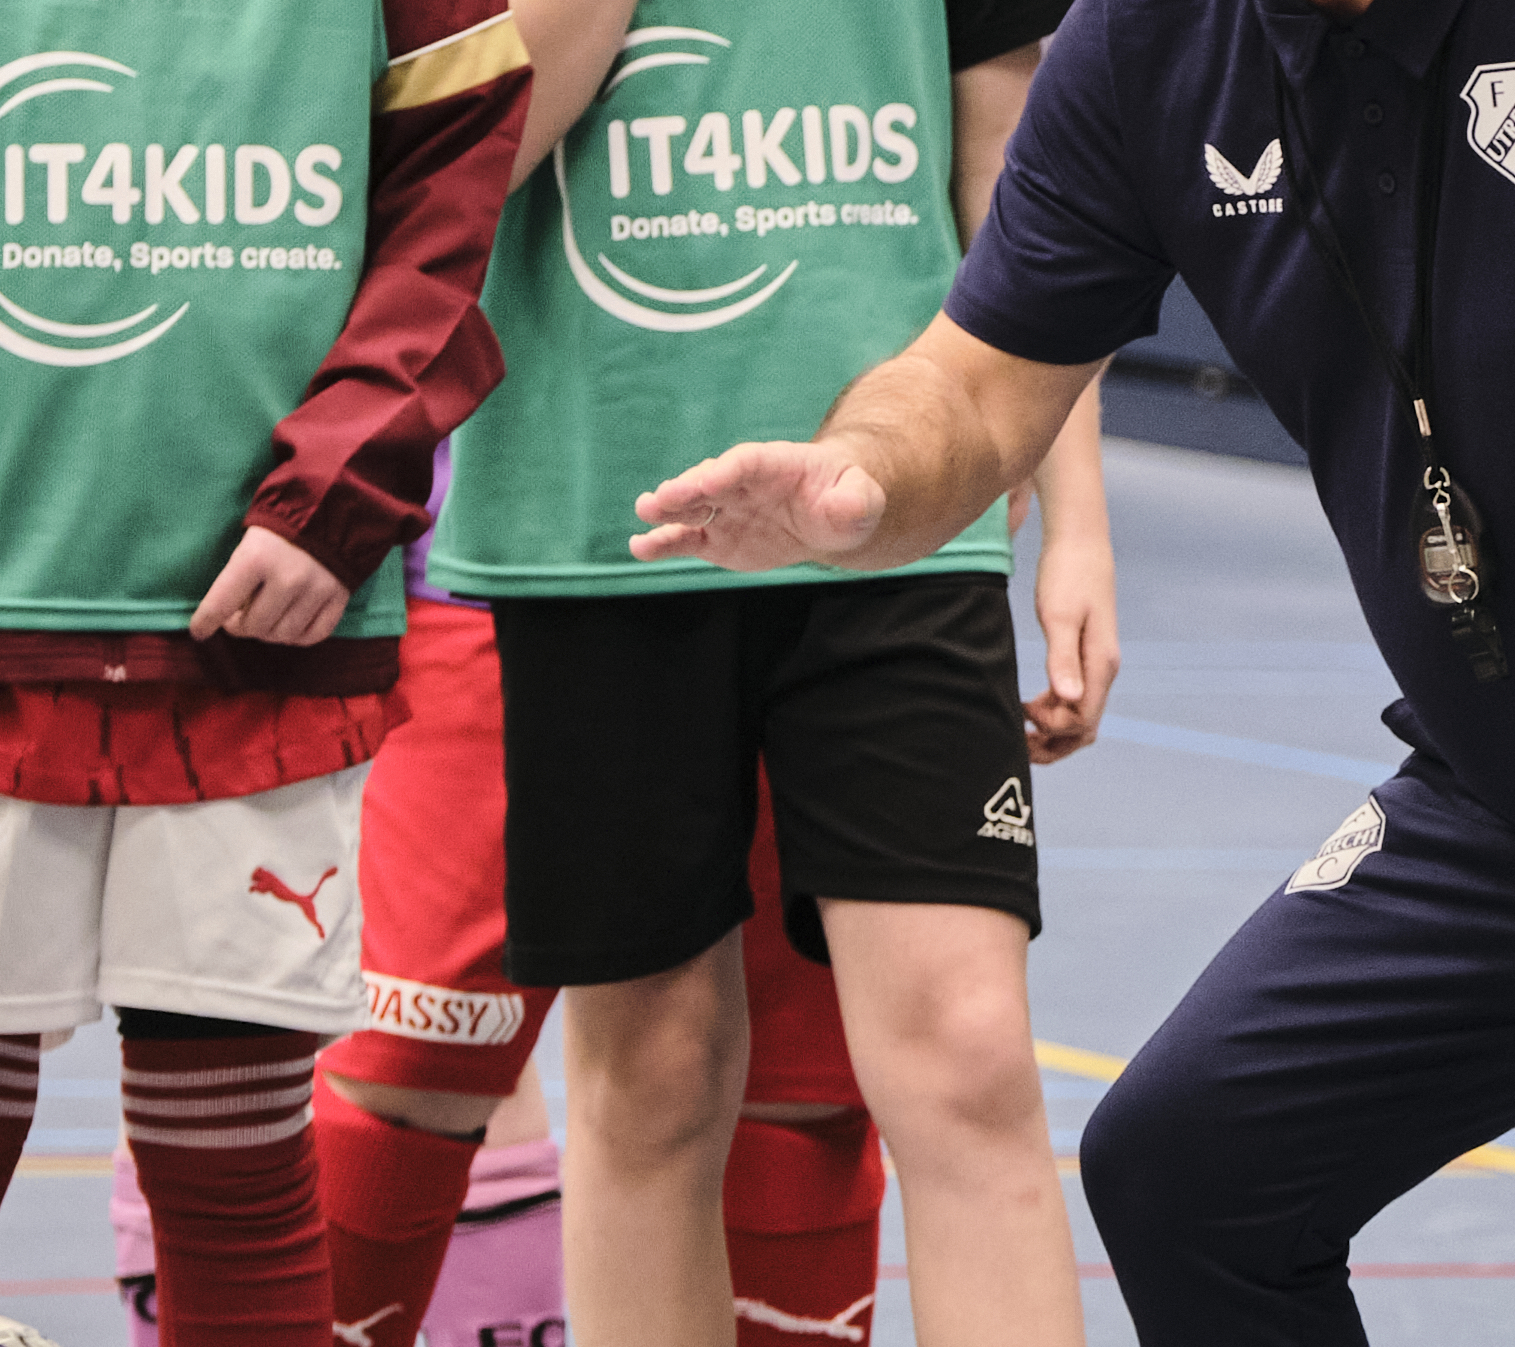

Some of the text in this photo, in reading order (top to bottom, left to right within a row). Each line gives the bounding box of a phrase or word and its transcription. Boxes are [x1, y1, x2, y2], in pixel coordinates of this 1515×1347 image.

[607, 102, 919, 199] IT4KIDS
[4, 142, 343, 227] IT4KIDS
[611, 200, 919, 241] Donate, Sports create.
[1212, 197, 1284, 217] CASTORE
[2, 242, 342, 275] Donate, Sports create.
